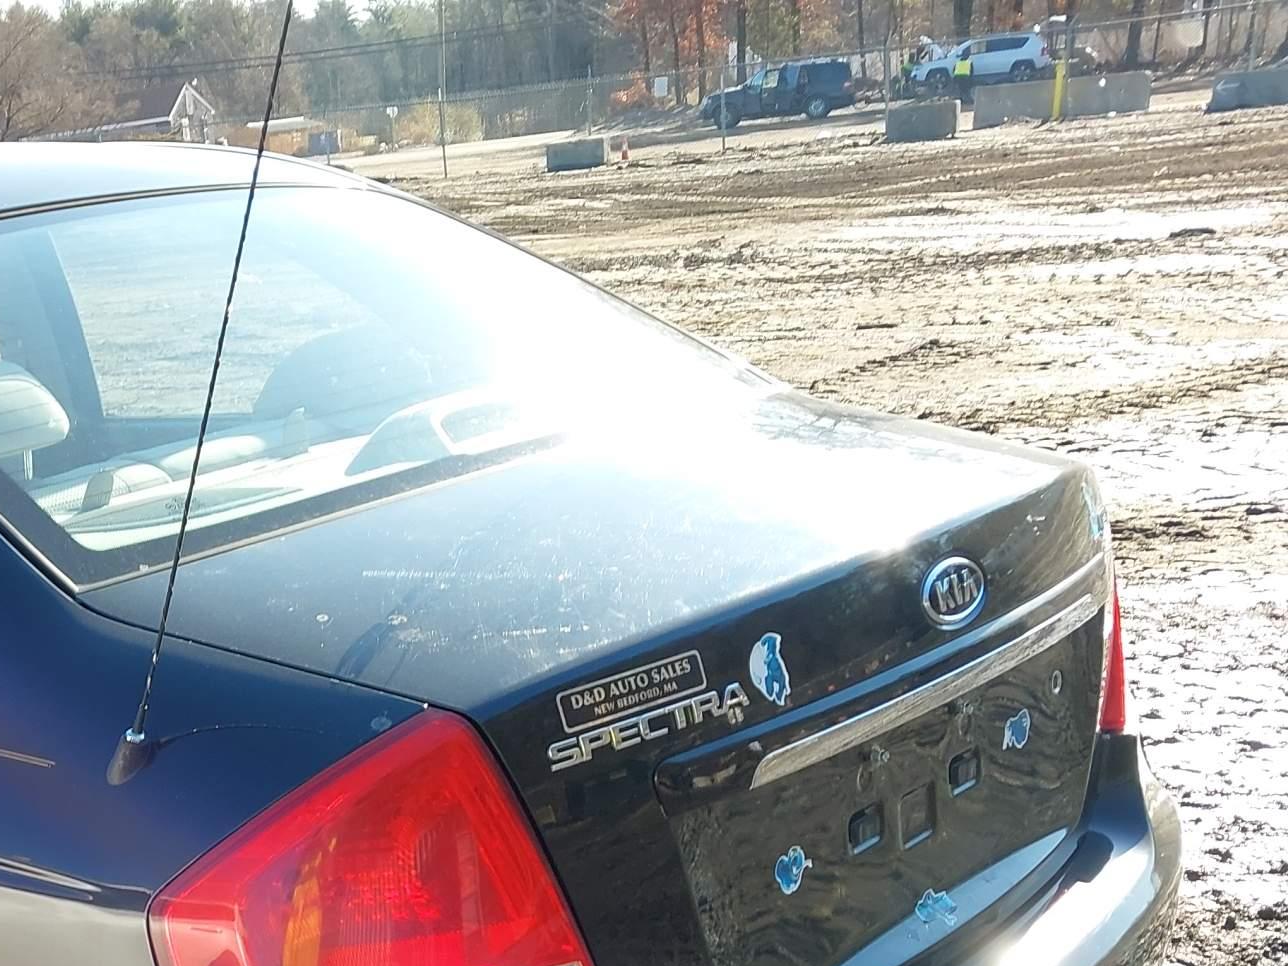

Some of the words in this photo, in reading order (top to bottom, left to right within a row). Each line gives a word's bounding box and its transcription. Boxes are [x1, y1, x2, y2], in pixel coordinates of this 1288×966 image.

[934, 568, 978, 613] KIA
[571, 687, 606, 710] D&D
[610, 673, 649, 698] AUTO
[651, 659, 691, 684] SALES
[594, 701, 616, 717] NEW
[617, 686, 663, 709] BEDFORD,
[663, 681, 679, 695] MA
[547, 682, 750, 772] SPECTRA
